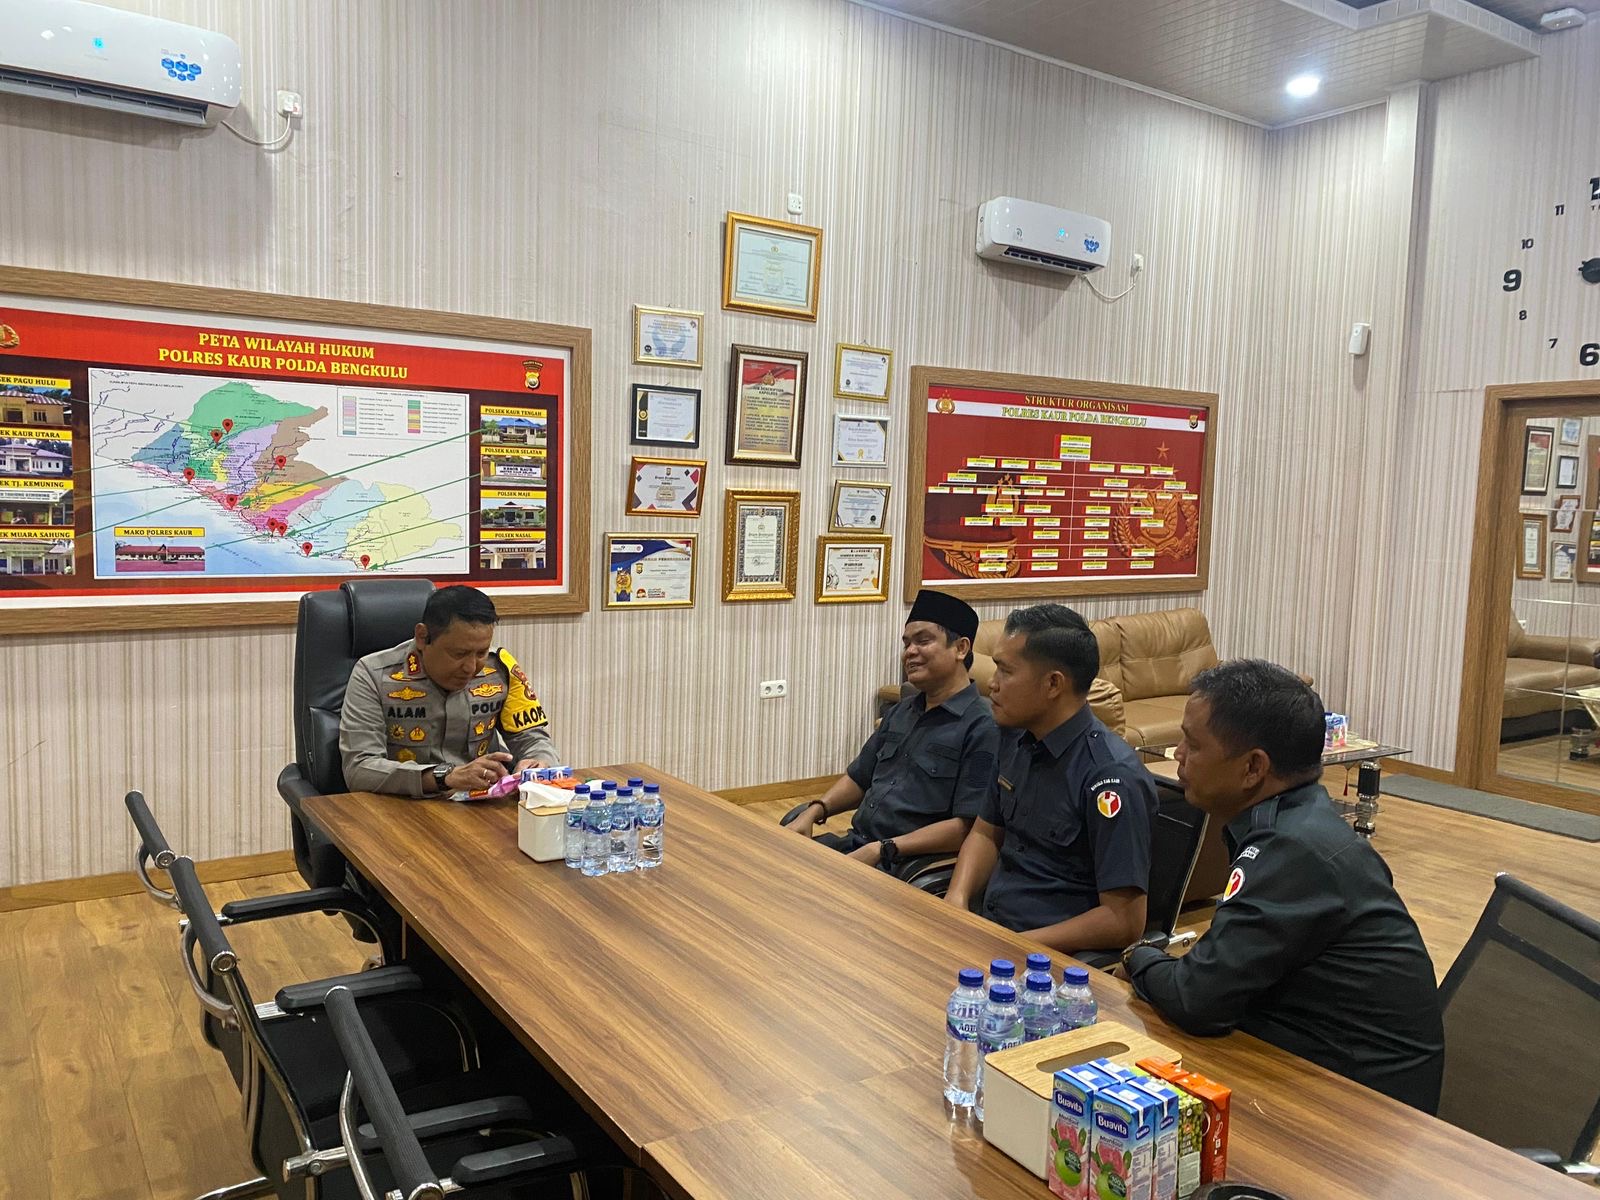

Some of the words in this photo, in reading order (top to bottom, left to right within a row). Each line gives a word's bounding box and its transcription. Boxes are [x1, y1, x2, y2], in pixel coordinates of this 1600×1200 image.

[1590, 177, 1600, 201] 1
[1555, 204, 1565, 216] 11
[1521, 238, 1534, 249] 10
[1502, 269, 1522, 292] 9
[1518, 310, 1527, 321] 8
[198, 332, 240, 349] PETA
[244, 336, 315, 355] WILAYAH
[319, 343, 375, 359] HUKUM
[1549, 338, 1558, 349] 7
[158, 348, 223, 365] POLRES
[227, 354, 272, 369] KAUR
[275, 358, 327, 373] POLDA
[330, 361, 408, 379] BENGKULU
[1579, 343, 1600, 366] 6
[1025, 395, 1074, 408] STRUKTUR
[1076, 399, 1129, 412] ORGANISASI
[1002, 406, 1040, 418] POLRES
[1040, 409, 1068, 421] KAUR
[1068, 411, 1100, 423] POLDA
[1100, 414, 1148, 427] BENGKULU
[23, 480, 64, 488] KEMUNING
[387, 706, 426, 719] ALAM
[1057, 1093, 1083, 1114] Buavita
[1098, 1115, 1127, 1135] Buavita
